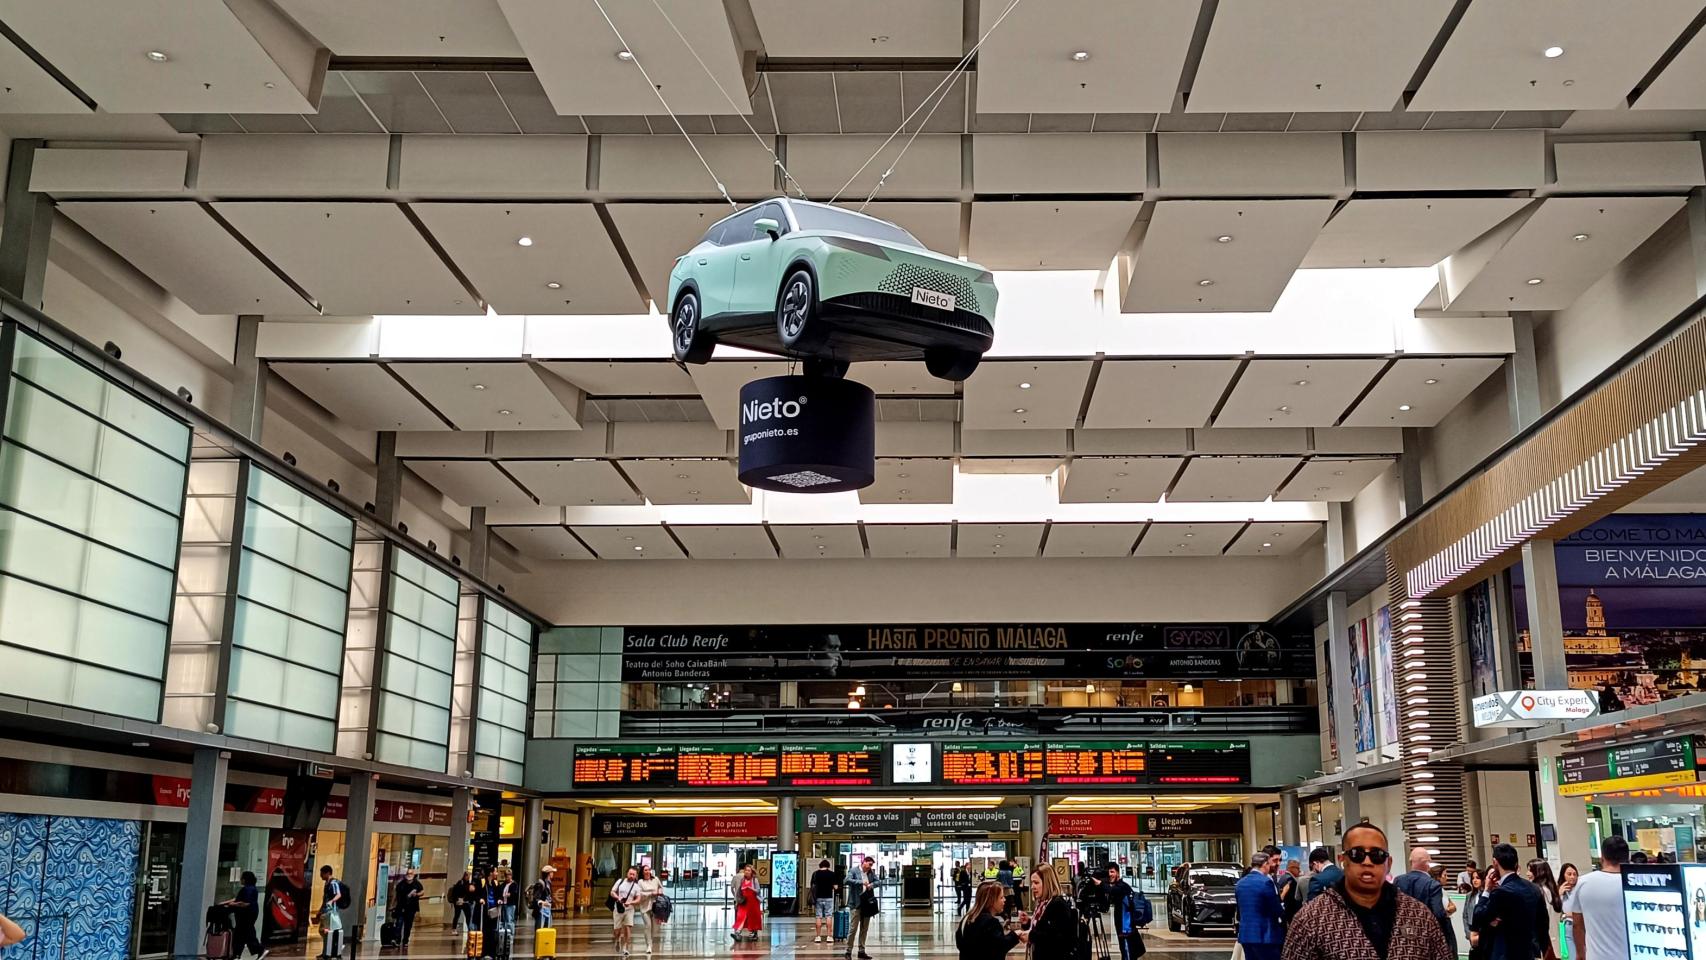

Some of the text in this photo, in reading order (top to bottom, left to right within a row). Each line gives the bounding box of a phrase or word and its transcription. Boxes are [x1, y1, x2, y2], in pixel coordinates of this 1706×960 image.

[916, 289, 948, 308] Nieto
[744, 428, 799, 445] gruponieto.es
[1643, 528, 1671, 541] TO
[1605, 563, 1706, 579] A MÁLAGA
[626, 634, 729, 650] Sala Club Renfe
[924, 628, 990, 649] PRONTO
[997, 624, 1068, 648] MÁLAGA
[1106, 629, 1144, 645] renfe
[625, 660, 728, 668] Teatro del Soho CaixaBank
[641, 669, 710, 677] Antonio Banderas
[1537, 696, 1589, 707] City Expert
[923, 712, 973, 732] renfe
[270, 794, 283, 808] iryo
[823, 814, 845, 828] 1-8
[850, 813, 874, 821] Acceso
[927, 812, 954, 820] Control
[968, 813, 1006, 823] equipajes
[1071, 819, 1091, 827] pasar
[1161, 817, 1192, 826] Llegadas
[616, 821, 648, 829] Llegadas
[727, 821, 747, 829] pasar
